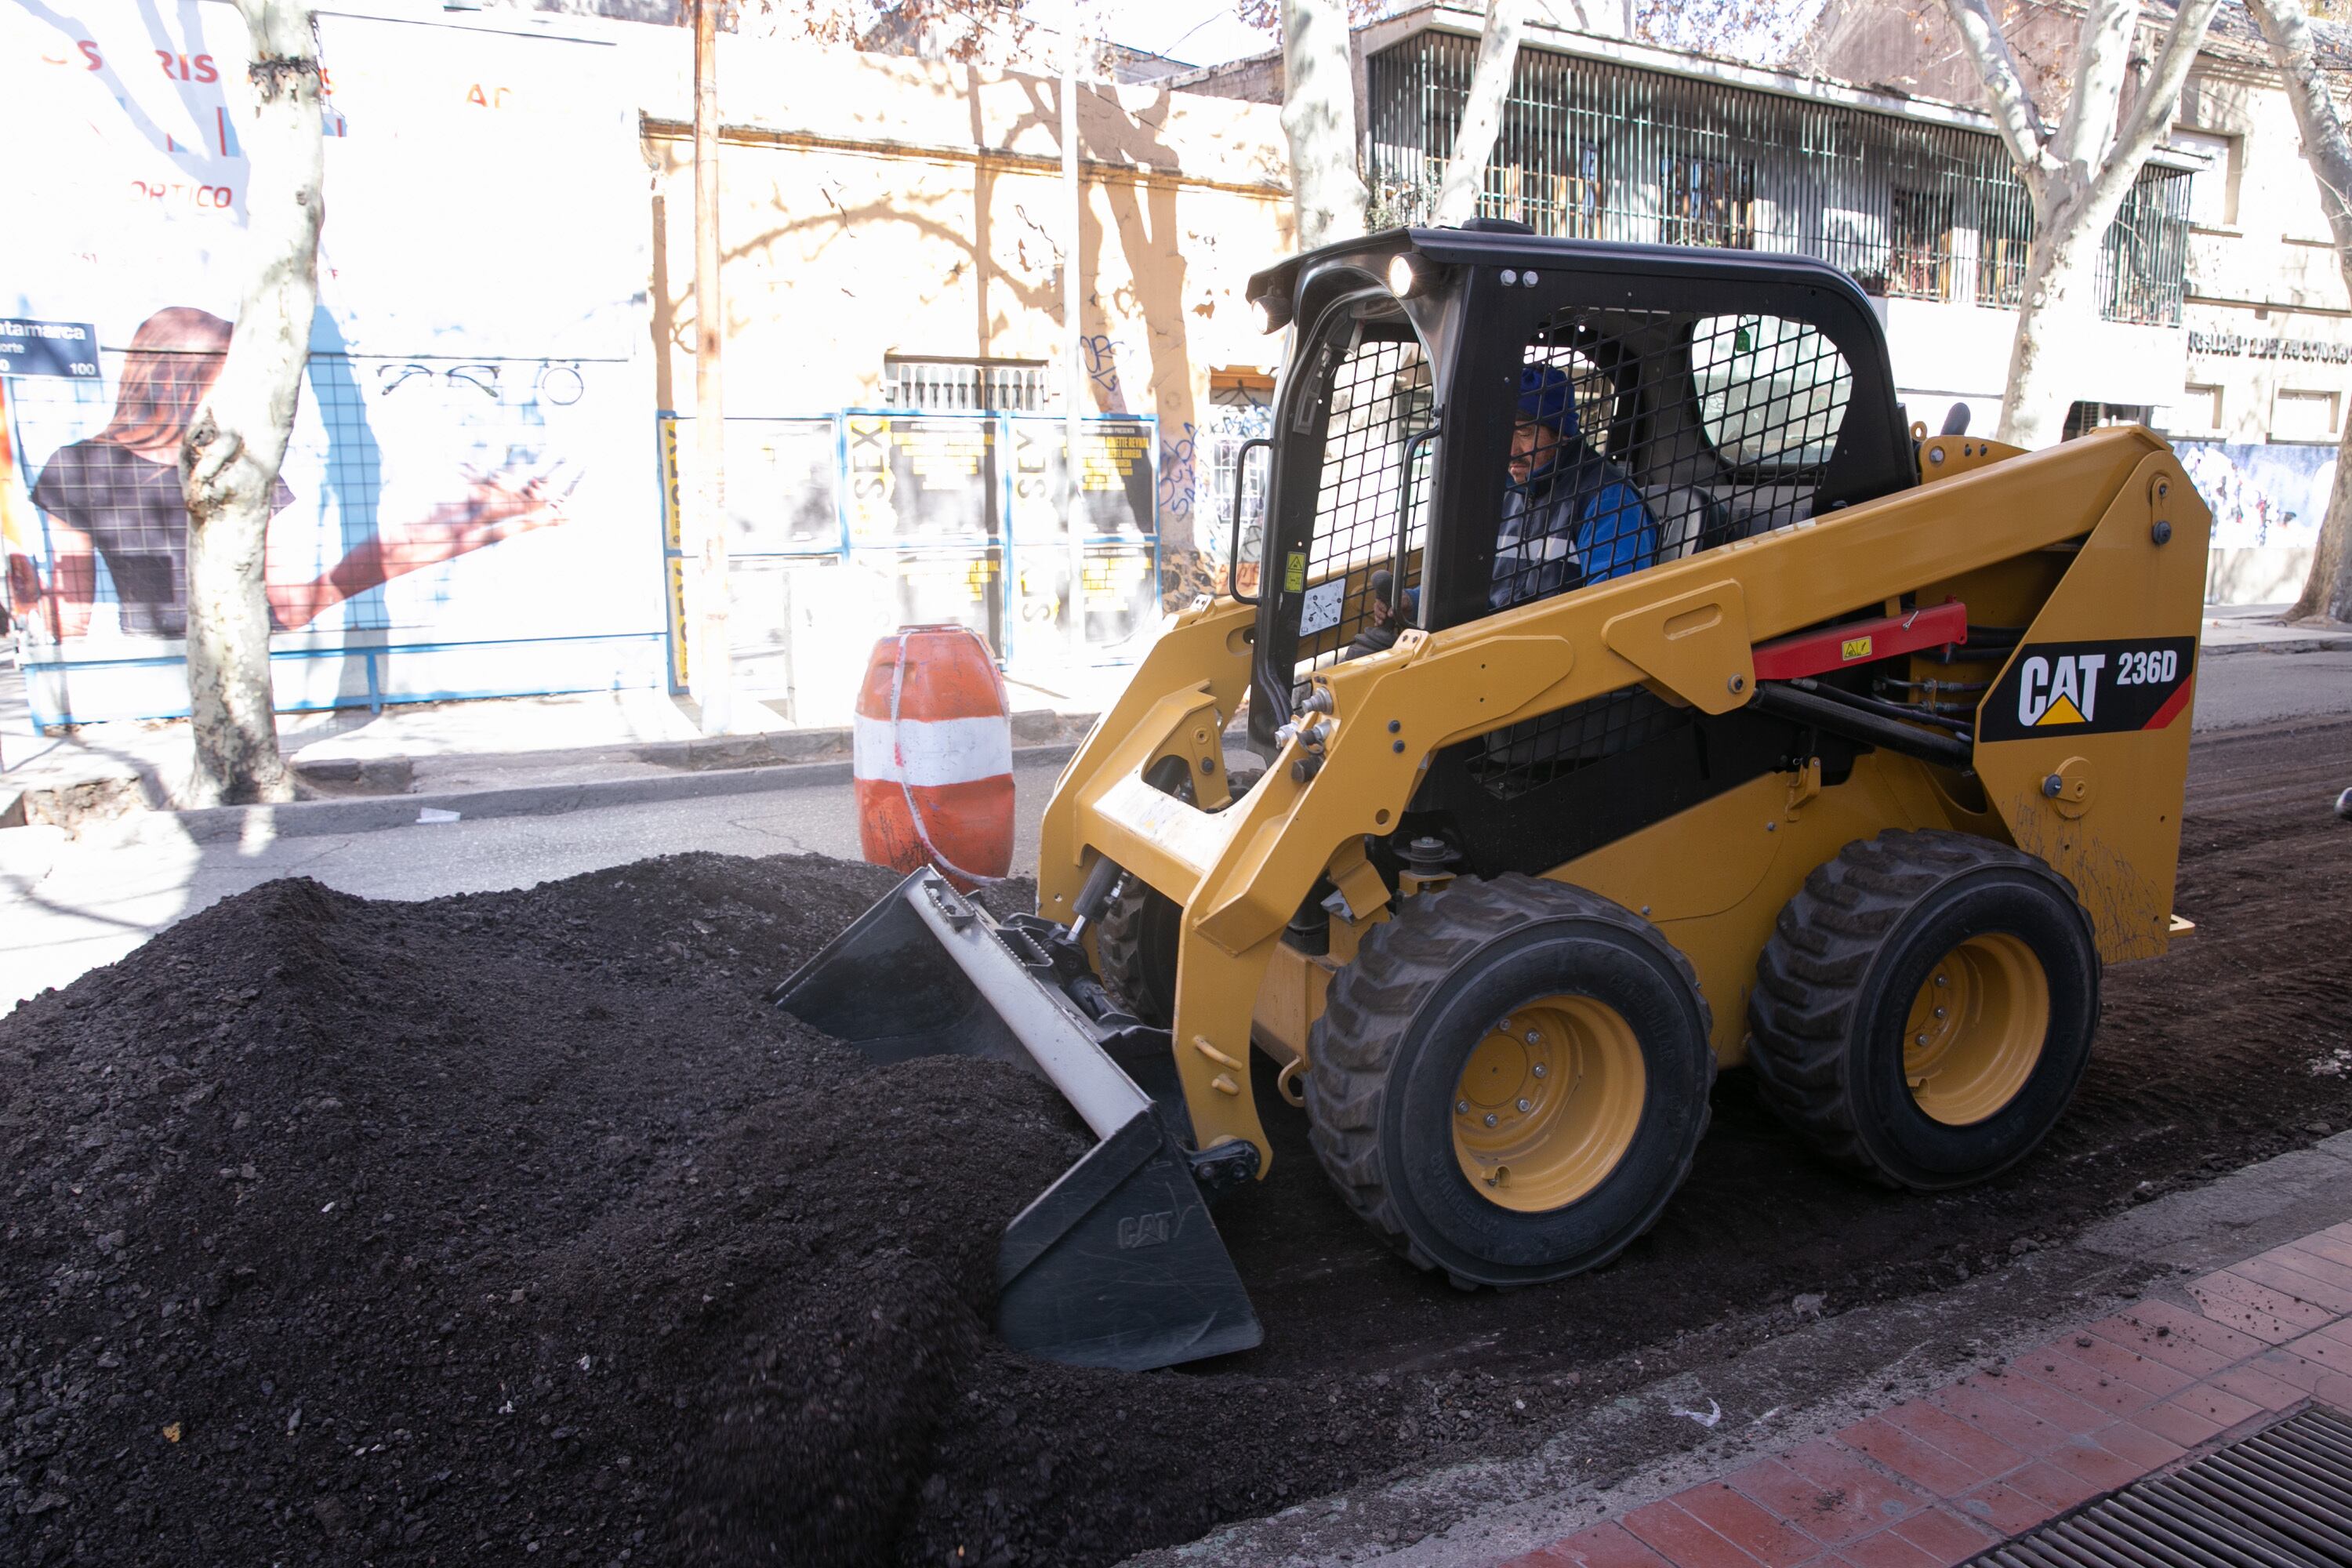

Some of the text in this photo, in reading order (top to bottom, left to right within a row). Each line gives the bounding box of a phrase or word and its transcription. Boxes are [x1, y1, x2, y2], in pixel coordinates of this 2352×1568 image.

[69, 362, 96, 376] 100
[851, 426, 885, 499] SEX
[2117, 650, 2177, 685] 236D
[2019, 655, 2106, 727] CAT
[1117, 1211, 1173, 1249] CAT
